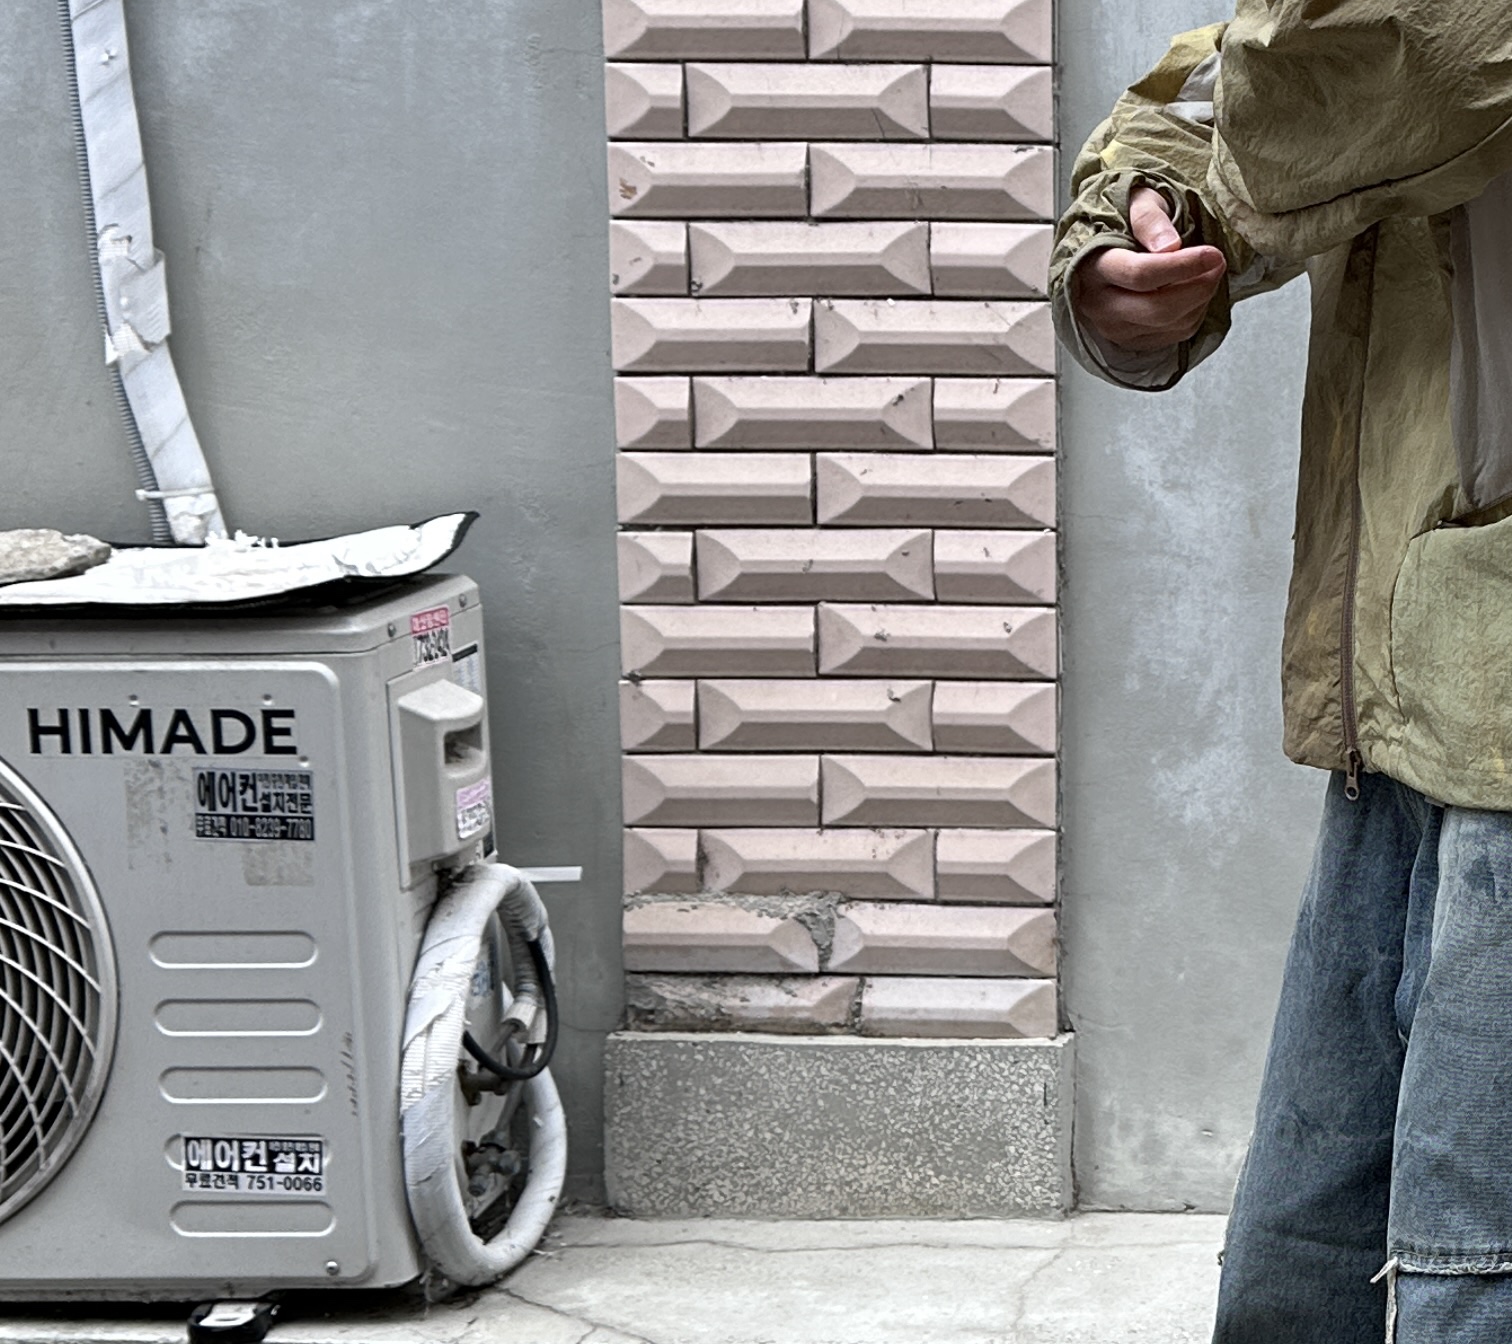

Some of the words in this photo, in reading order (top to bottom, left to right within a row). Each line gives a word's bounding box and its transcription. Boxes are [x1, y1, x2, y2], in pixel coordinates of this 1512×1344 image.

[26, 708, 298, 755] HIMADE
[197, 771, 259, 812] 에어컨
[187, 1139, 268, 1172] 에어컨
[273, 1151, 320, 1174] 설치
[185, 1172, 239, 1189] 무료견적
[247, 1174, 322, 1191] 751-0066
